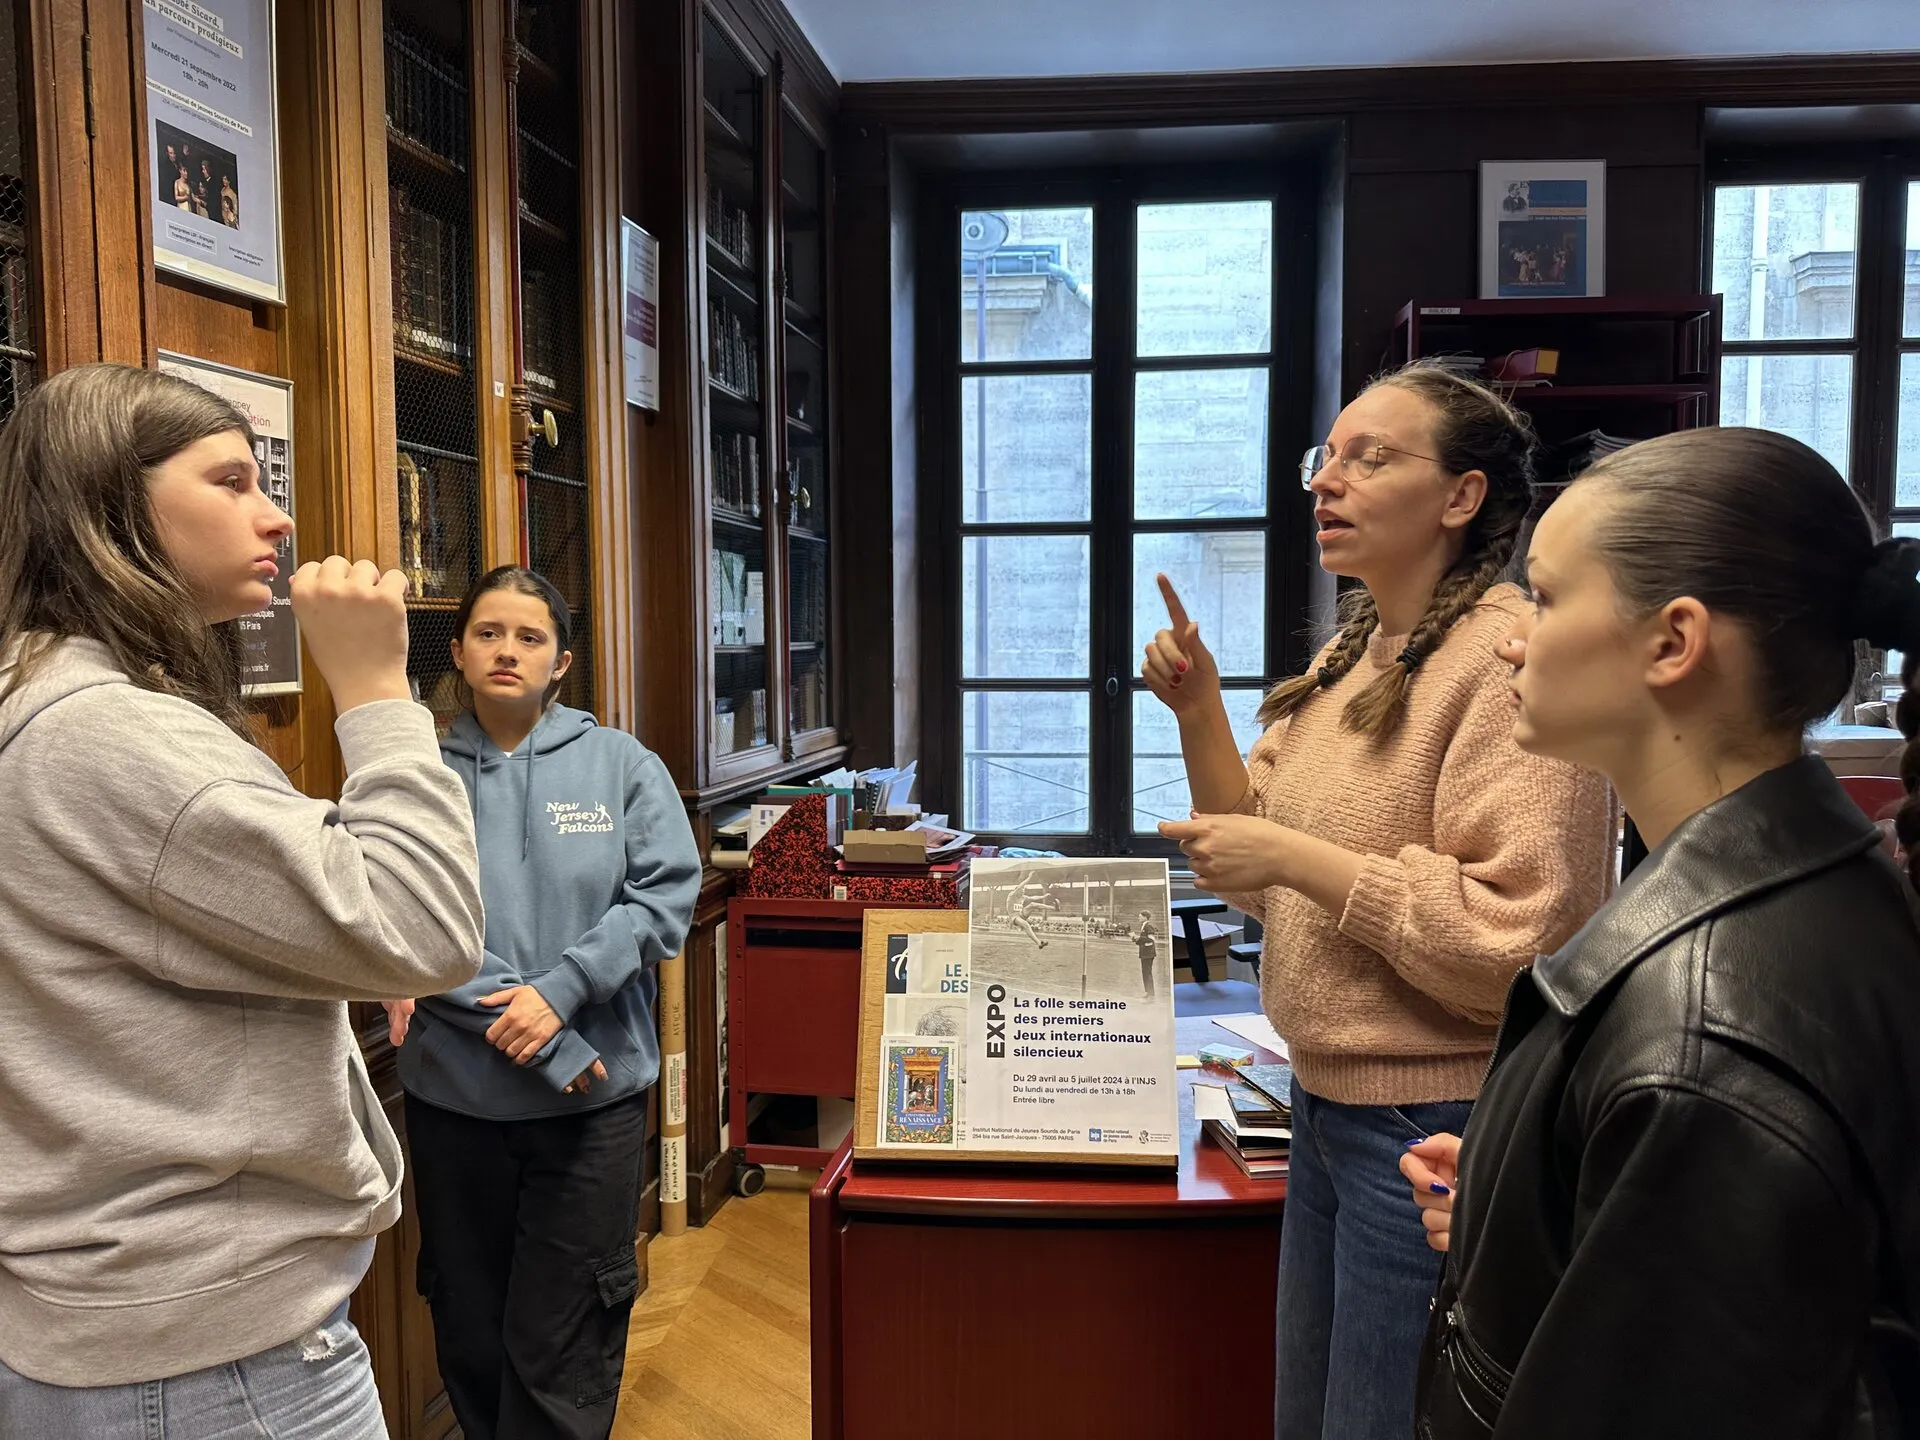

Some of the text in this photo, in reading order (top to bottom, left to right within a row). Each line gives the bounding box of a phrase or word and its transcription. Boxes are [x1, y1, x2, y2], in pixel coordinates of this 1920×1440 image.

[191, 4, 220, 29] Sicard,
[159, 3, 195, 29] parcours
[197, 25, 240, 54] prodigieux
[151, 41, 180, 62] Mercredi
[181, 57, 189, 67] 21
[189, 62, 222, 83] septembre
[222, 78, 237, 91] 2022
[167, 90, 190, 105] National
[190, 100, 197, 108] de
[213, 112, 230, 125] Sourds
[230, 119, 237, 127] de
[237, 122, 249, 134] Paris
[272, 595, 292, 606] Sourds
[545, 801, 580, 813] New
[550, 811, 599, 826] Jersey
[557, 821, 614, 835] Falcons
[945, 963, 962, 977] LE
[940, 980, 968, 993] DES
[1013, 996, 1127, 1010] La folle semaine
[986, 984, 1006, 1059] EXPO
[1013, 1013, 1104, 1027] des premiers
[1013, 1029, 1152, 1044] Jeux internationaux
[1013, 1046, 1084, 1058] silencieux
[1012, 1073, 1157, 1086] Du 29 avril au 5 juillet 2024 à l'INJS
[1012, 1085, 1136, 1096] Du lundi au vendredi de 13h à 18h
[1012, 1096, 1056, 1105] Entrée libre
[899, 1116, 942, 1124] RENAISSANCE
[1000, 1133, 1037, 1141] Saint-Jacques
